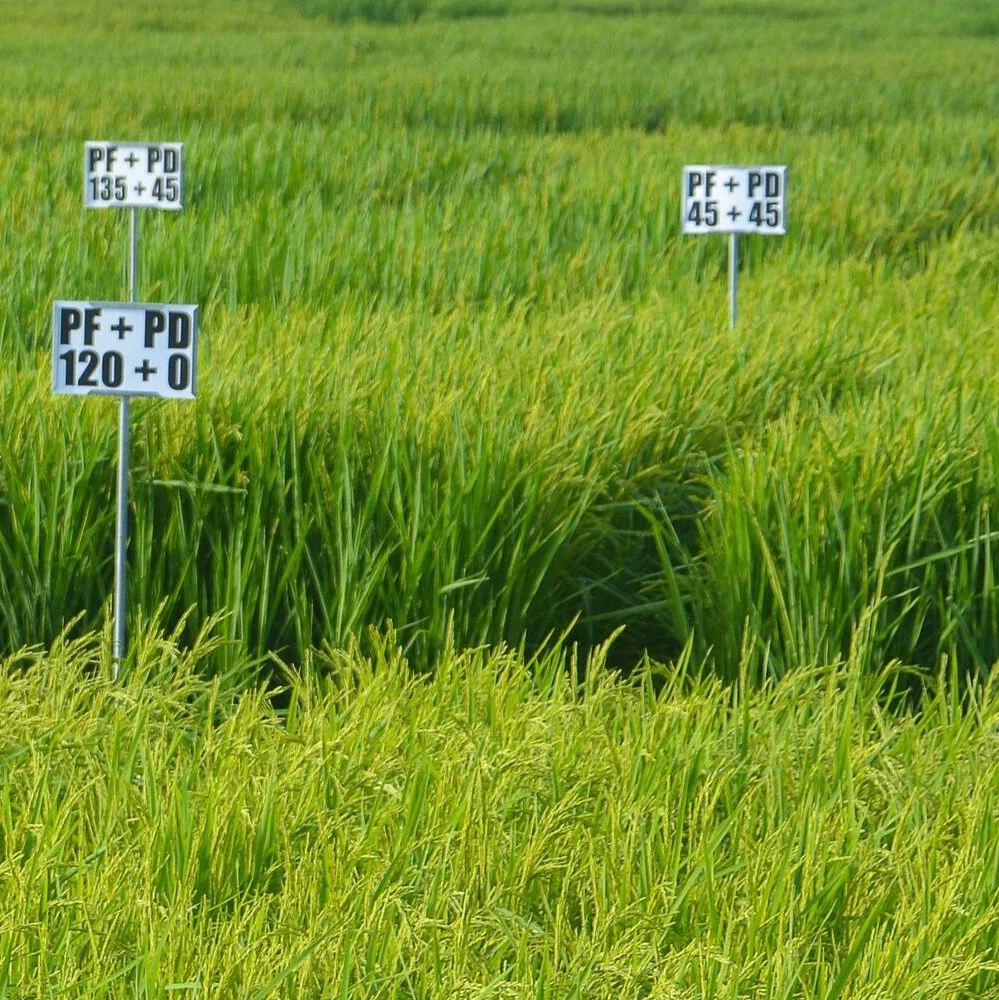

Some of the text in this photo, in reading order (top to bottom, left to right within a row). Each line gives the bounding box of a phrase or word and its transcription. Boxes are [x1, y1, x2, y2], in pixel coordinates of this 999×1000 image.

[89, 147, 178, 174] PF + PD
[89, 176, 178, 202] 135 + 45
[688, 172, 780, 198] PF + PD
[688, 201, 780, 228] 45 + 45
[60, 307, 191, 349] PF + PD
[59, 349, 190, 391] 120 + 0
